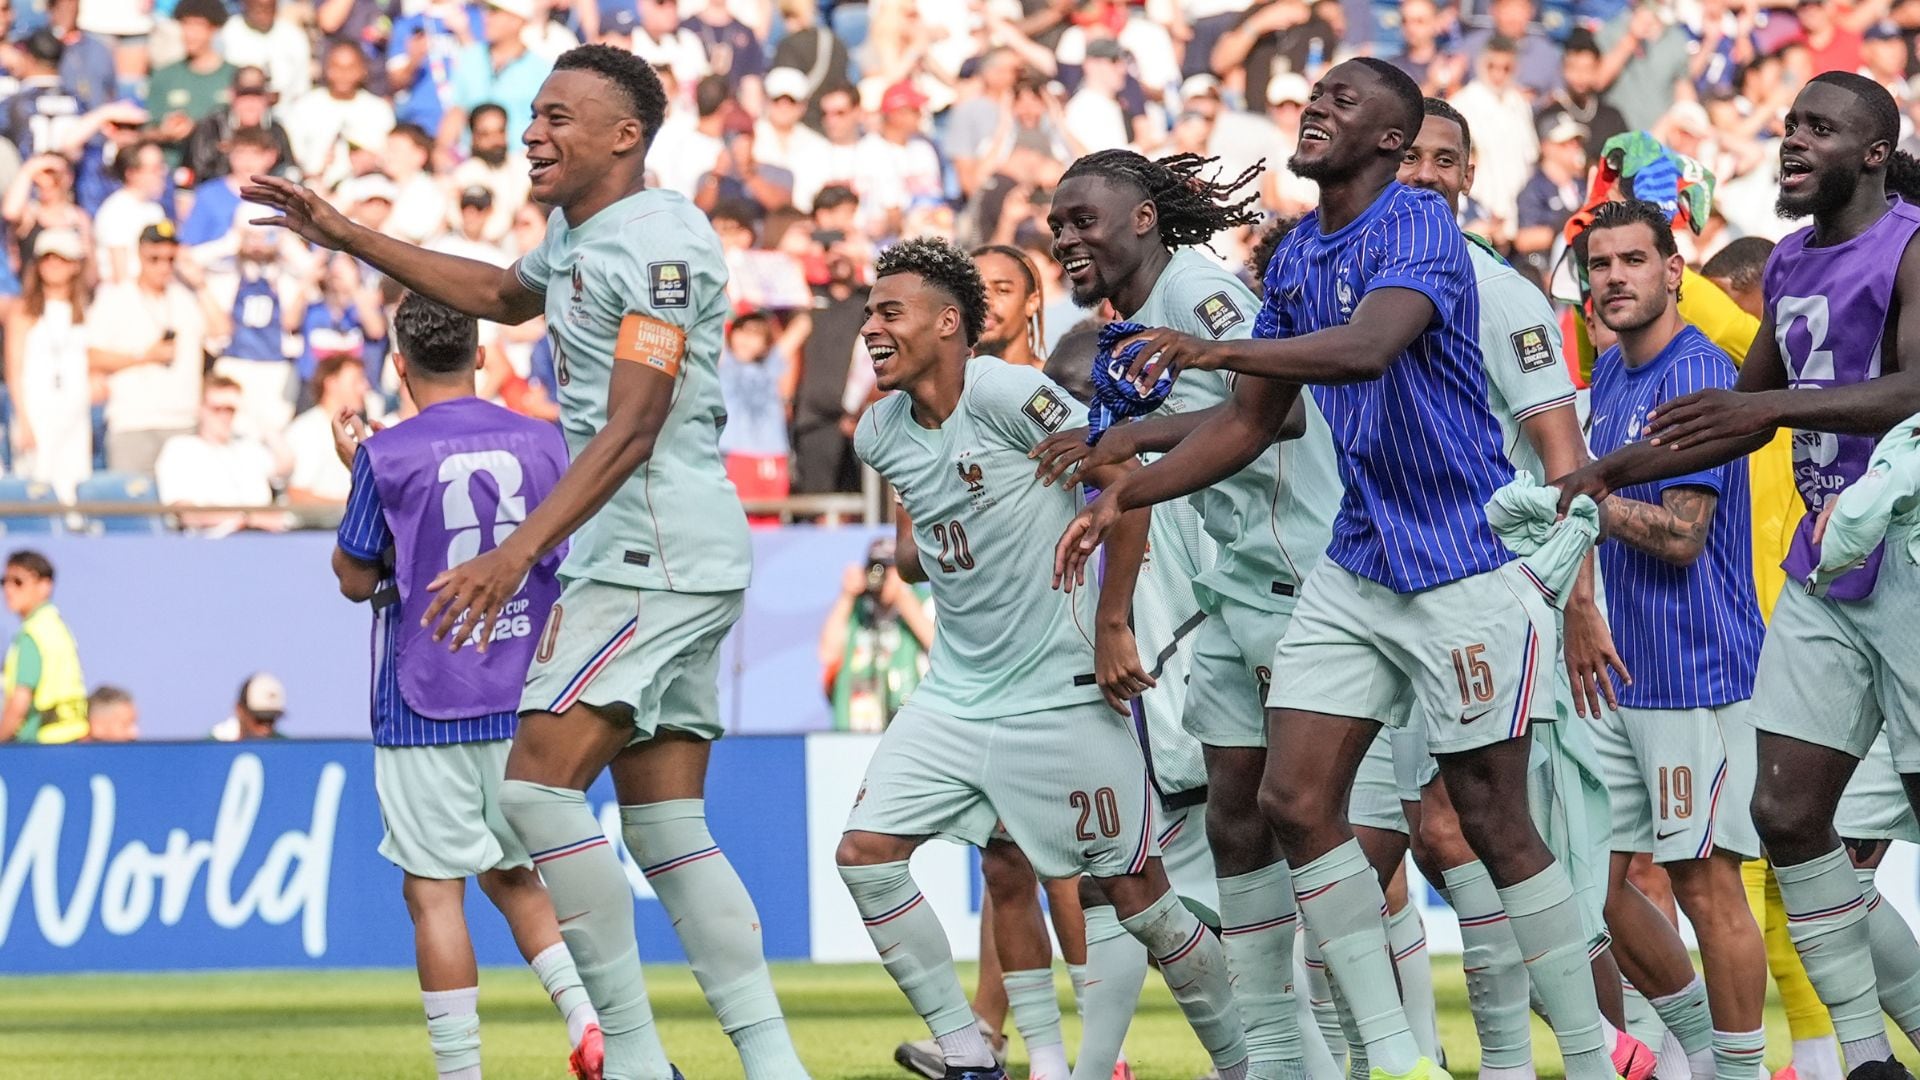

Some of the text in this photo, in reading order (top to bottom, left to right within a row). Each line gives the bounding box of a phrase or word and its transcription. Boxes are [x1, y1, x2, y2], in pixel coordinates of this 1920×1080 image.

[932, 520, 975, 574] 20
[505, 598, 530, 616] CUP
[536, 603, 563, 664] 0
[1450, 643, 1495, 706] 15
[1069, 786, 1121, 842] 20
[1658, 765, 1693, 820] 19
[0, 752, 347, 959] World
